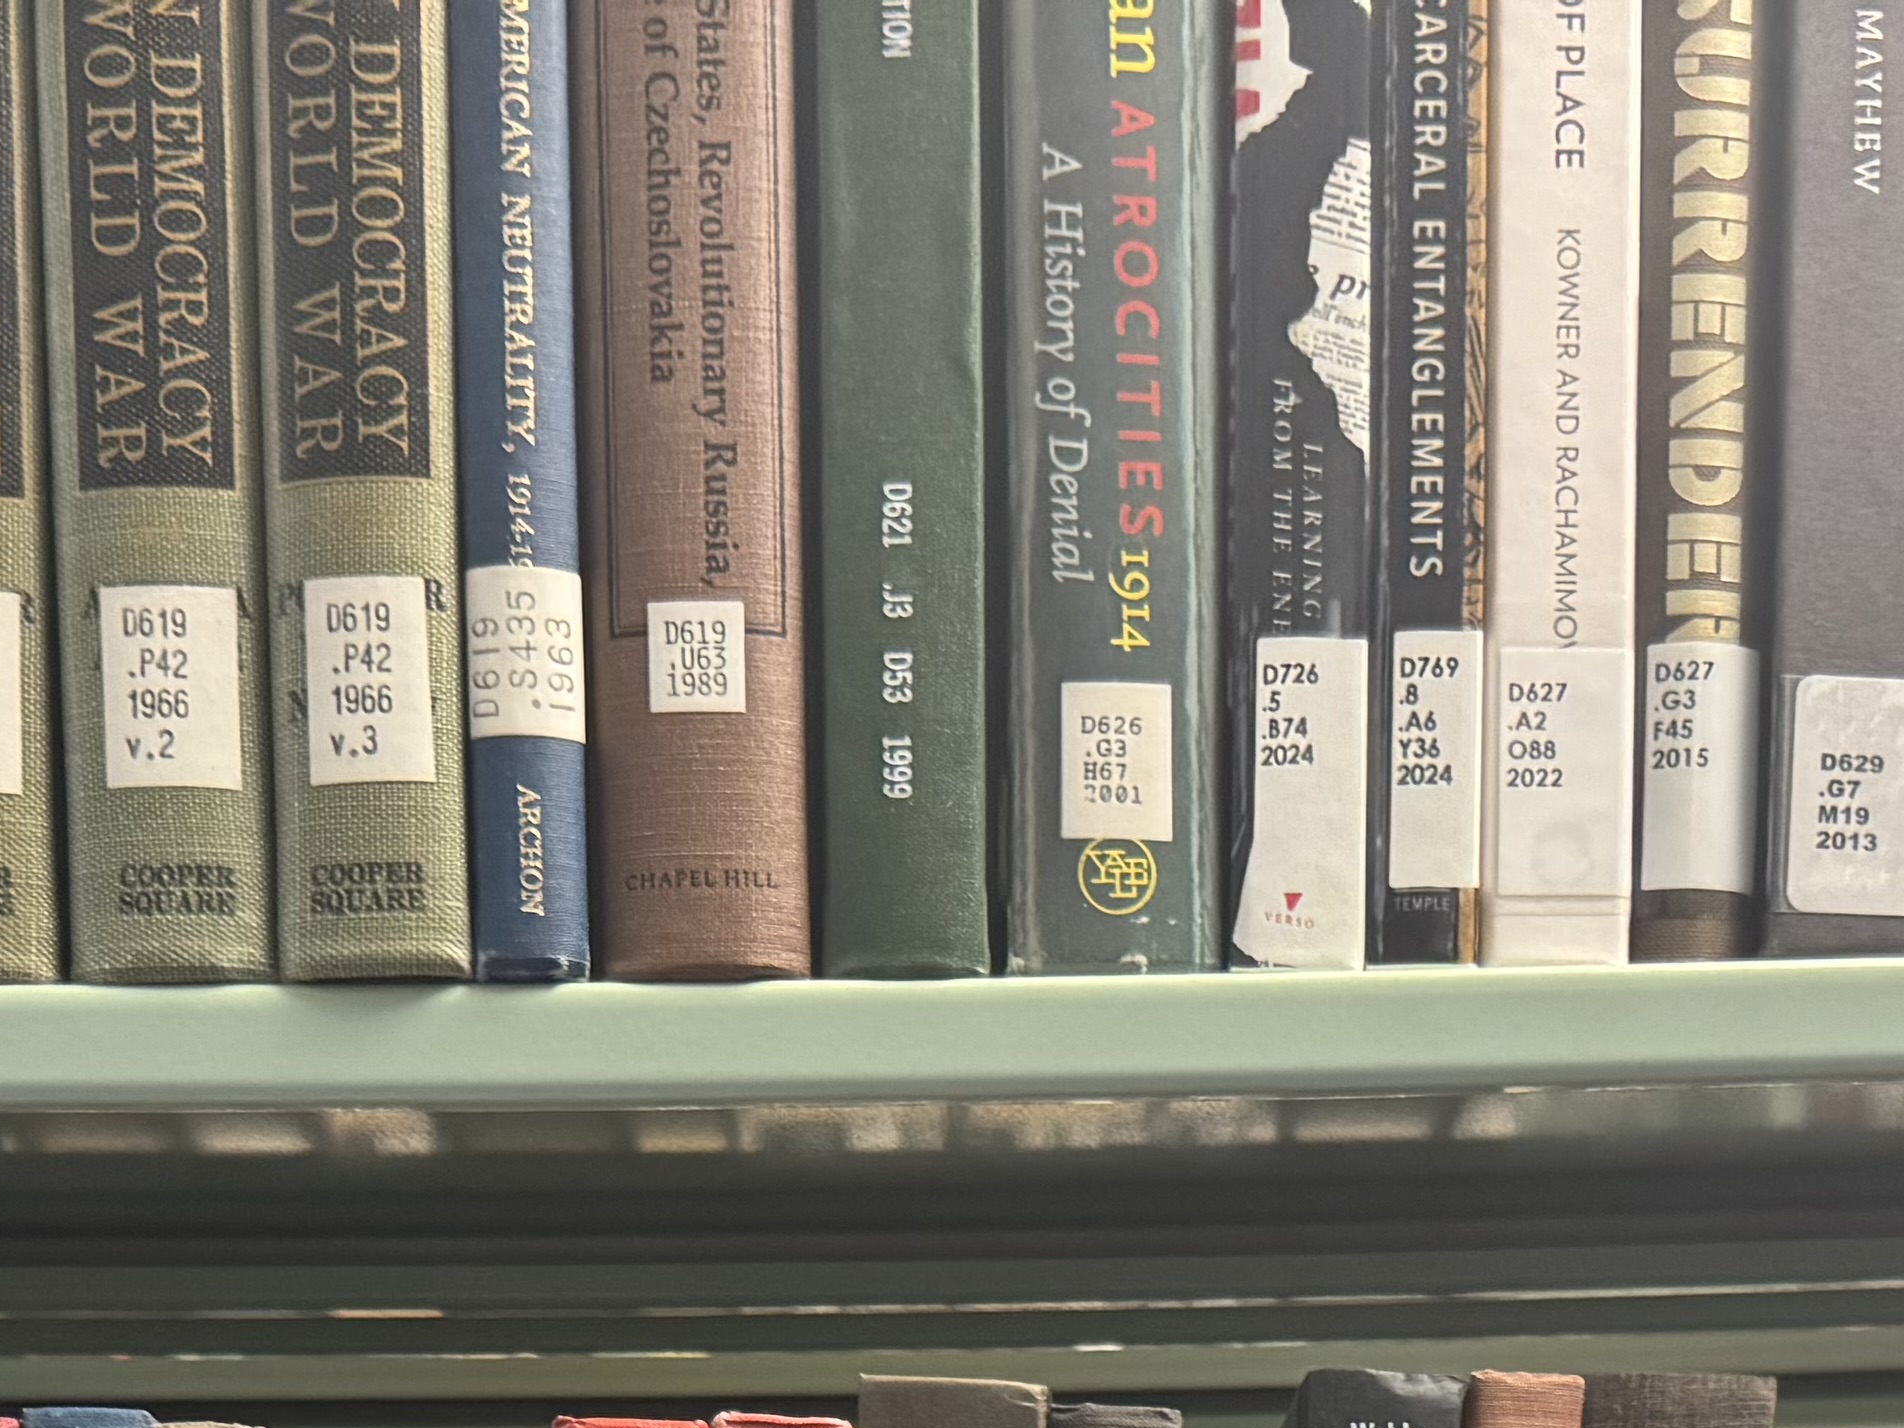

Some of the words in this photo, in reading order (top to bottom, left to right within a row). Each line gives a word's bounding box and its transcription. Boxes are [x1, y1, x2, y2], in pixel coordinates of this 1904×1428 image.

[645, 17, 678, 56] of
[1854, 9, 1884, 195] MAYHEW
[1044, 142, 1083, 180] A
[645, 72, 678, 384] Czechoslovakia
[698, 141, 737, 432] Revolutionary
[1036, 199, 1085, 368] History
[1108, 99, 1163, 538] ATROCITIES
[1554, 228, 1582, 361] KOWNER
[1036, 376, 1089, 428] of
[1411, 219, 1446, 578] ENTANGLEMENTS
[1555, 371, 1580, 436] AND
[704, 441, 740, 588] Russia,
[1051, 439, 1094, 584] Denial
[1108, 549, 1151, 651] 1914
[1261, 719, 1308, 739] .B74
[1262, 664, 1319, 686] D726
[1262, 692, 1280, 712] .5
[1261, 746, 1314, 766] 2024
